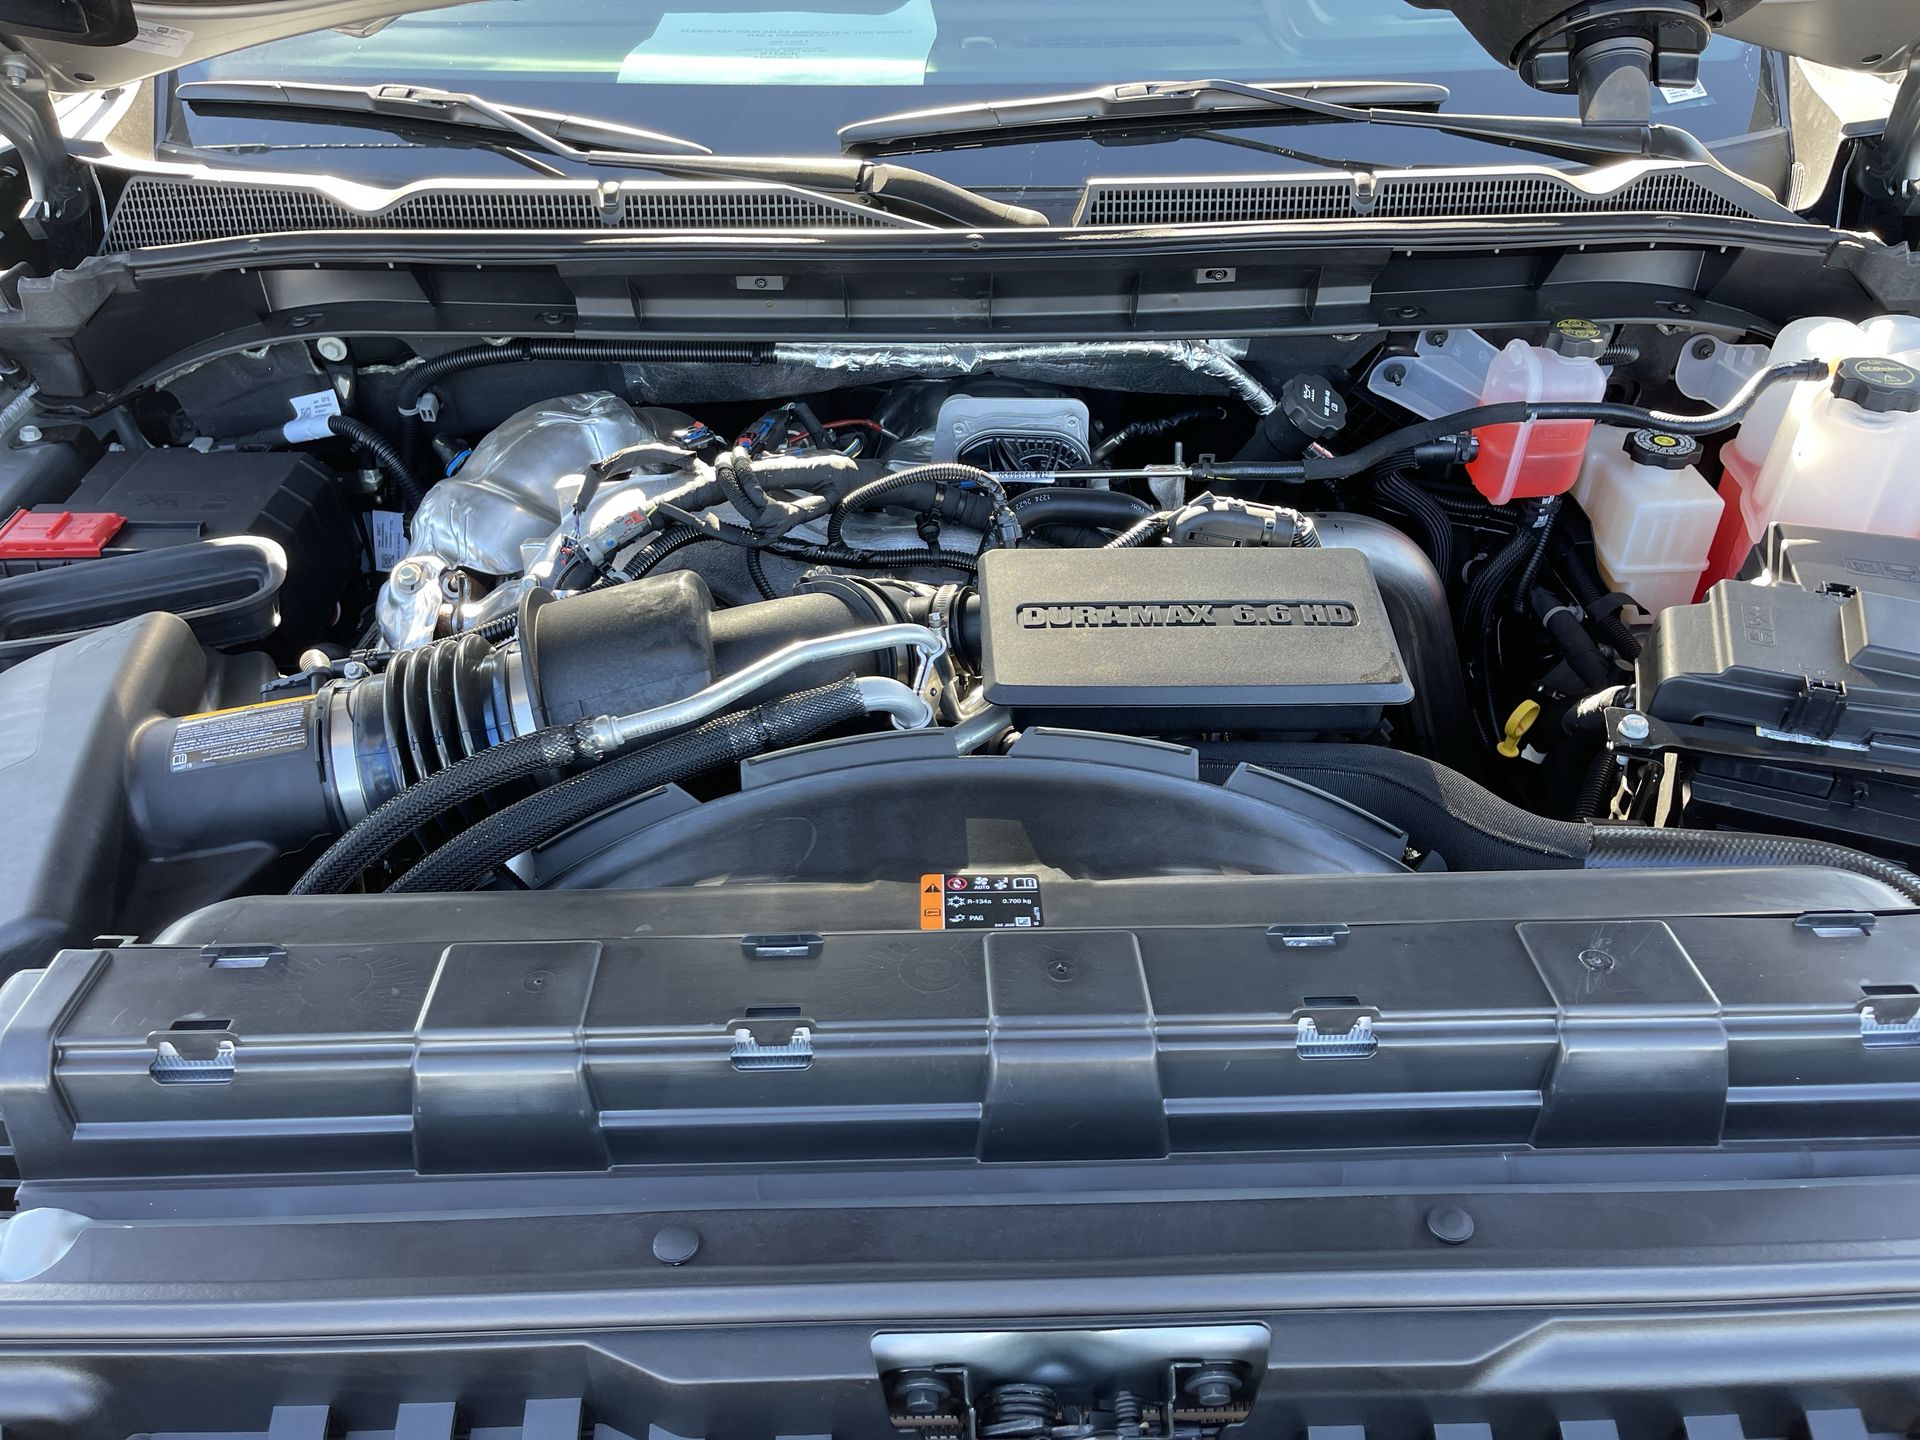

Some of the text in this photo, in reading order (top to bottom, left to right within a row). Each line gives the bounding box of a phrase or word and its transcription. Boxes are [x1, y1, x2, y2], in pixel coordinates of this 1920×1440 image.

[1022, 603, 1355, 628] DURAMAX 6.6 HD
